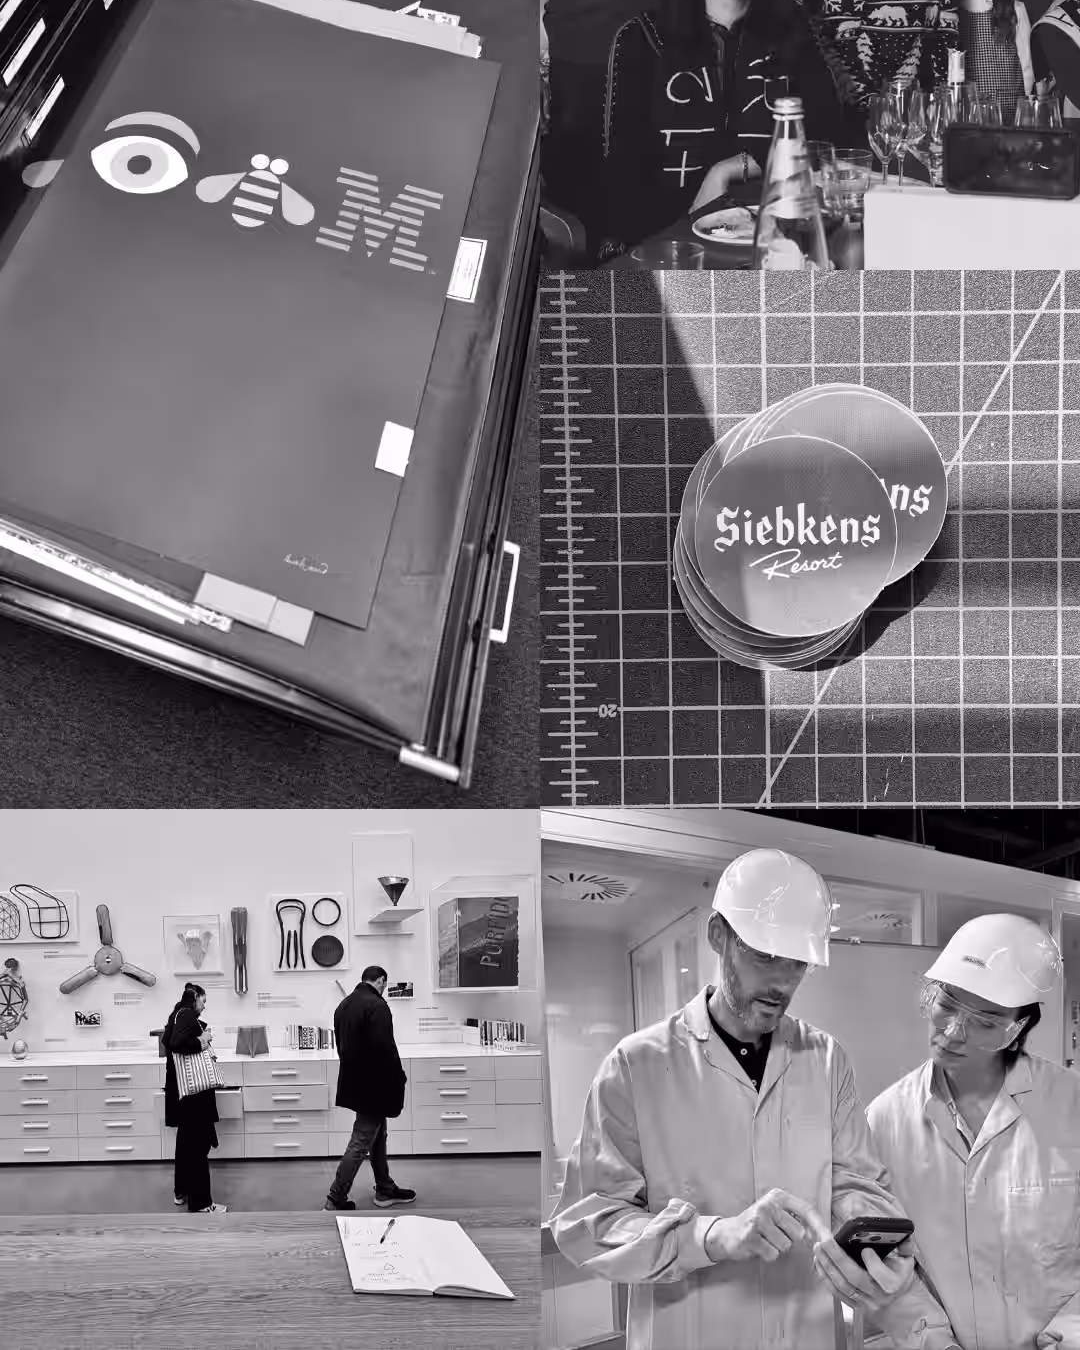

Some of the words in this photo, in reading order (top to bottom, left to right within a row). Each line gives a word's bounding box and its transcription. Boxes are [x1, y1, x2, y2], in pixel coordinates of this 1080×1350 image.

[714, 503, 881, 552] Siebkens
[750, 548, 842, 580] Resort
[599, 703, 617, 718] 20
